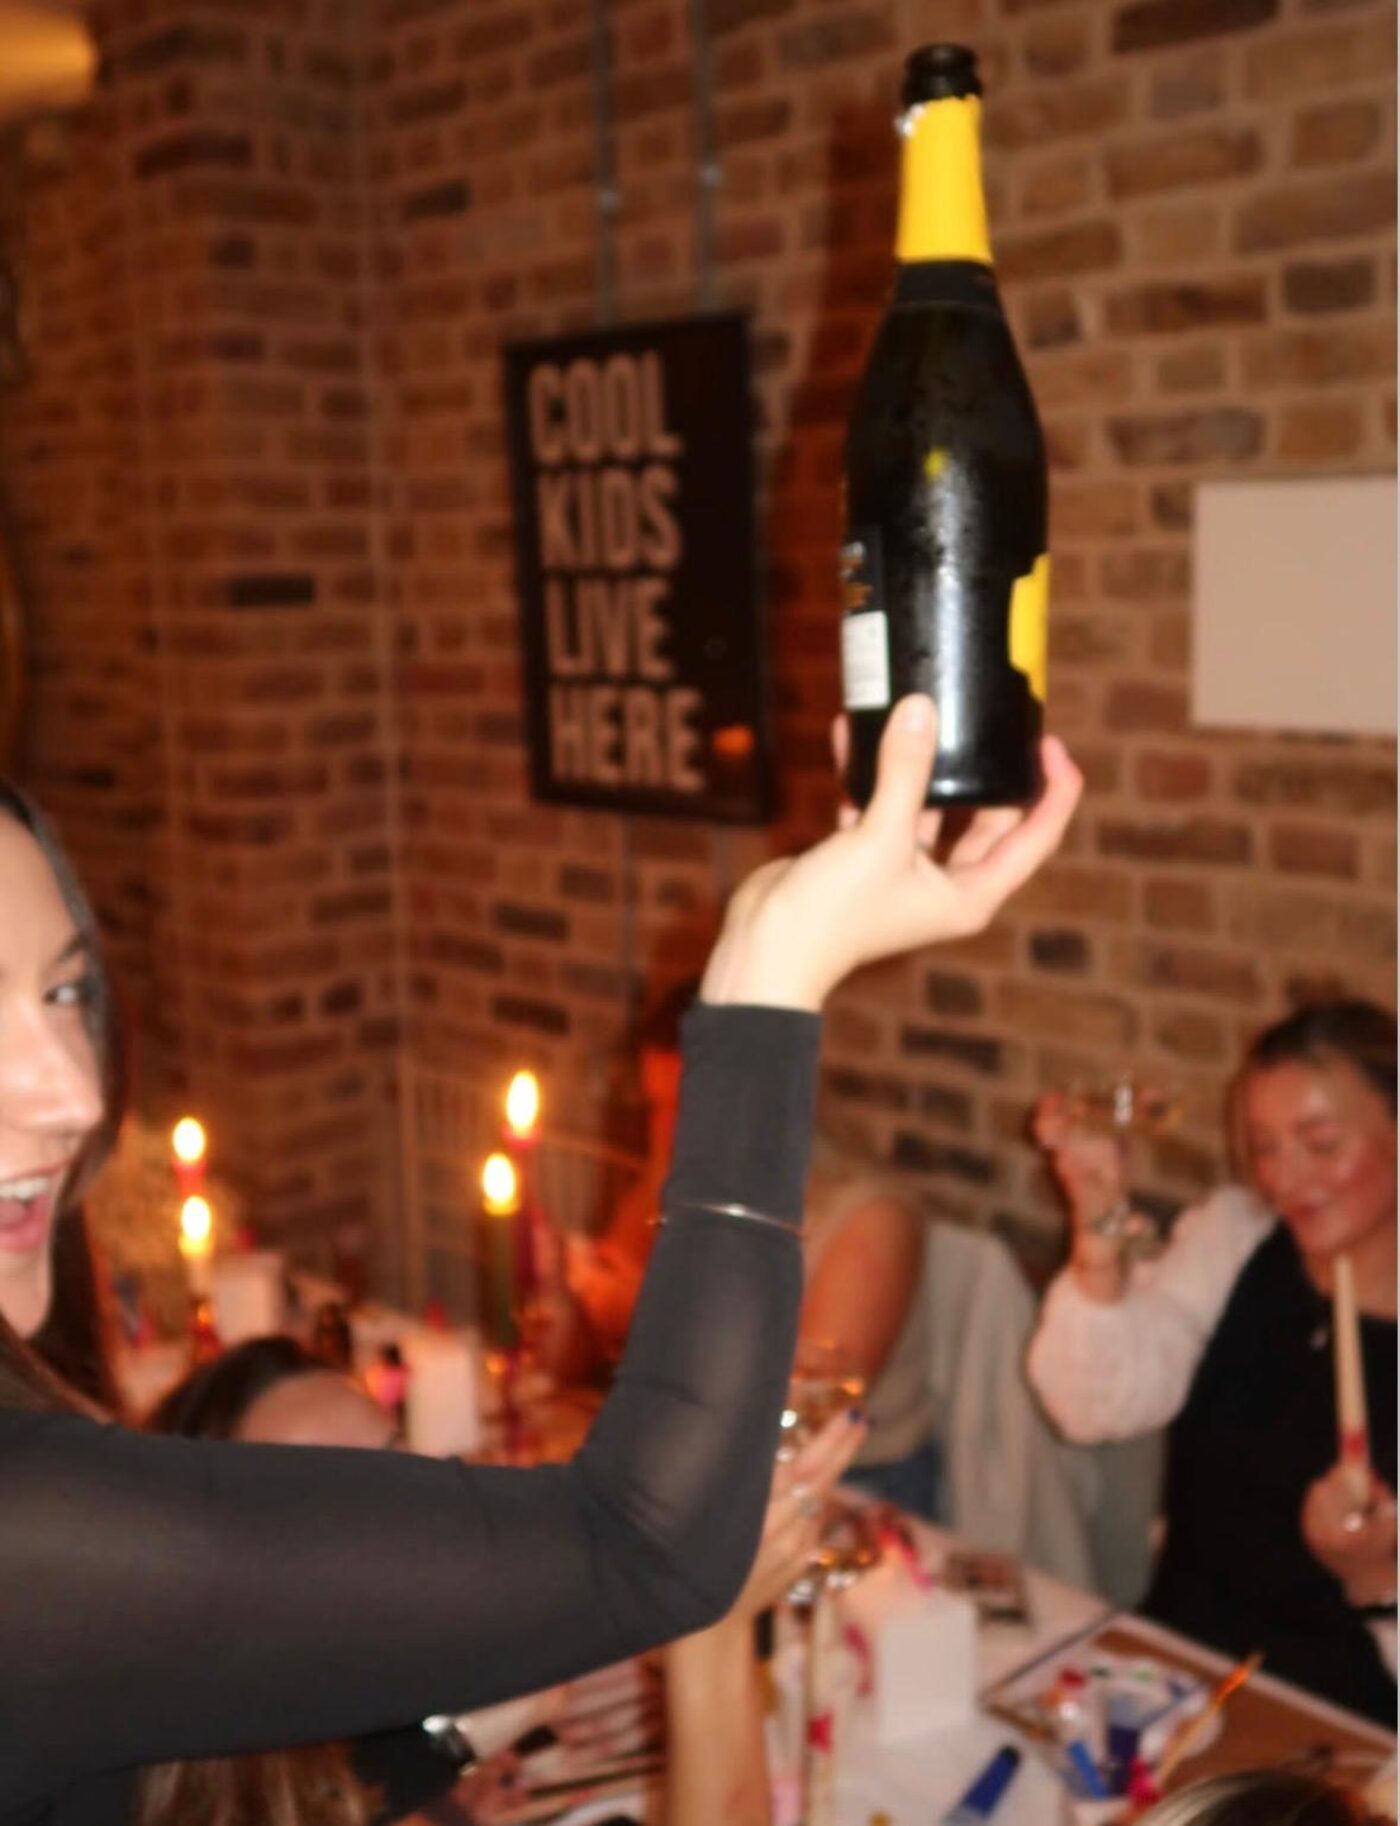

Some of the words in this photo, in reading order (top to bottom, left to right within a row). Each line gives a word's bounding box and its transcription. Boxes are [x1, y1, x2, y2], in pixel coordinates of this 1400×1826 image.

[528, 350, 681, 464] COOL
[537, 464, 681, 571] KIDS
[546, 575, 675, 679] LIVE
[549, 686, 704, 792] HERE
